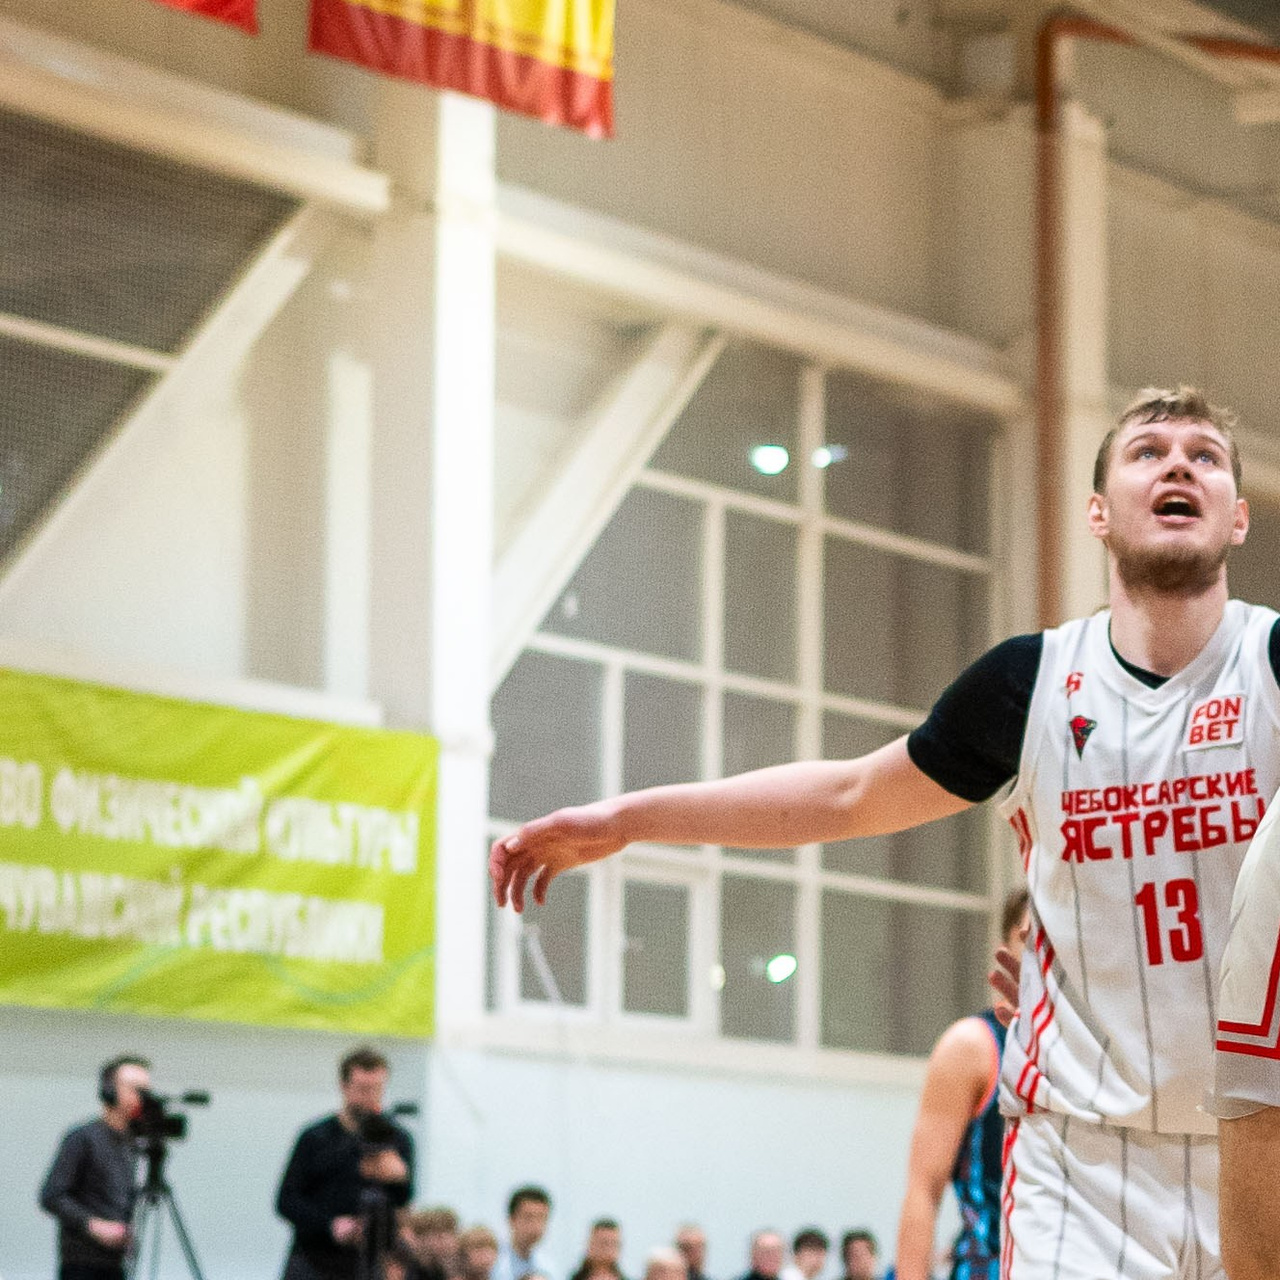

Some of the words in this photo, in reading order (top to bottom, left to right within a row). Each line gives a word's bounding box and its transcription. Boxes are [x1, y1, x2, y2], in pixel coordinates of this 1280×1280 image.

[1190, 719, 1238, 745] BET
[1193, 697, 1241, 724] FON
[1061, 768, 1258, 816] ЧЕБОКСАРСКИЕ
[1060, 797, 1266, 863] ЯСТРЕБЫ
[1134, 878, 1204, 966] 13
